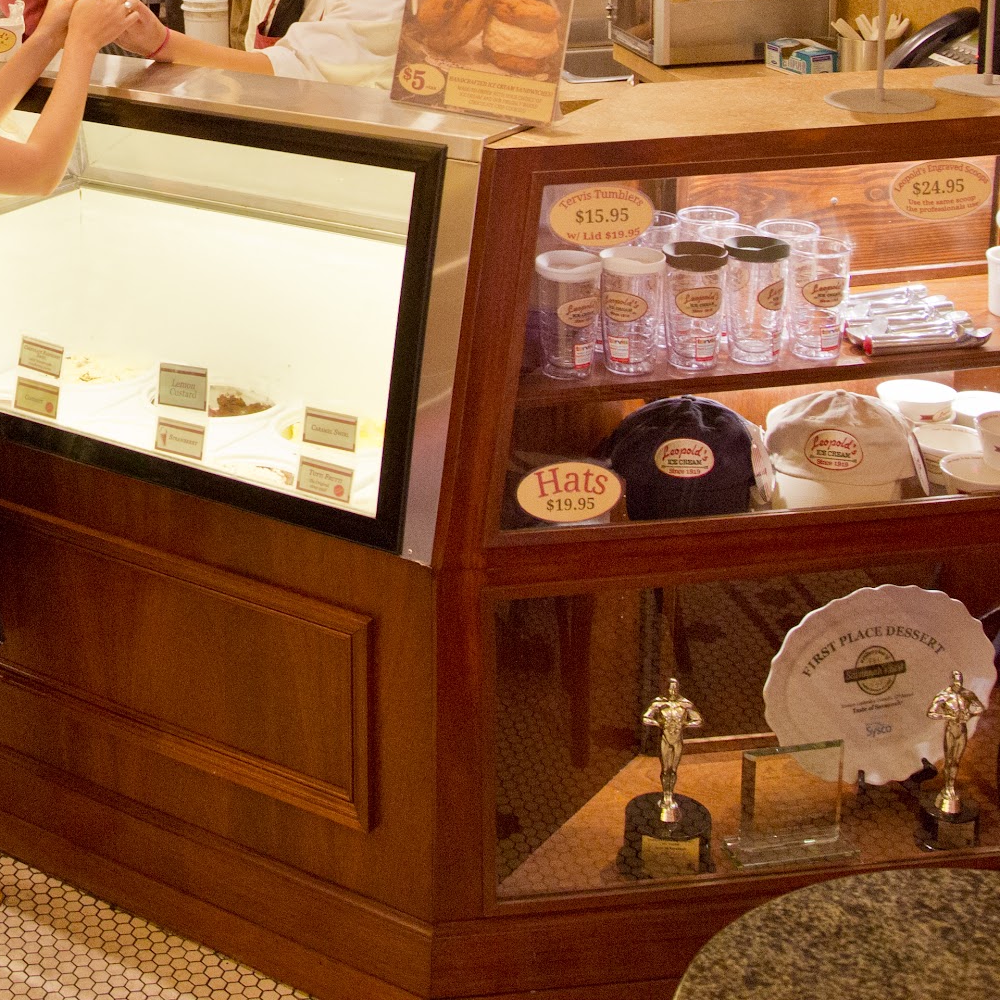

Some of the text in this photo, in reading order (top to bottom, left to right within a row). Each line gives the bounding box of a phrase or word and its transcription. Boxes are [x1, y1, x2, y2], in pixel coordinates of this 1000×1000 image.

[403, 67, 426, 90] $5
[496, 83, 515, 91] CREAM
[894, 164, 989, 192] Leopold's Engraved Scoops
[912, 178, 964, 196] $24.95
[559, 189, 644, 210] Tervis Tumblers
[956, 195, 976, 203] scoop
[575, 207, 629, 224] $15.95
[919, 203, 966, 213] professionals
[567, 227, 640, 241] w/ Lid $19.95
[171, 379, 196, 389] Lemon
[169, 388, 197, 398] Custard
[662, 444, 708, 461] Leopold's
[812, 435, 857, 455] Leopold's
[534, 467, 609, 498] Hats
[546, 497, 595, 512] $19.95
[802, 641, 837, 678] FIRST
[840, 626, 883, 647] PLACE
[886, 626, 945, 655] DESSERT
[866, 726, 892, 738] Sysco
